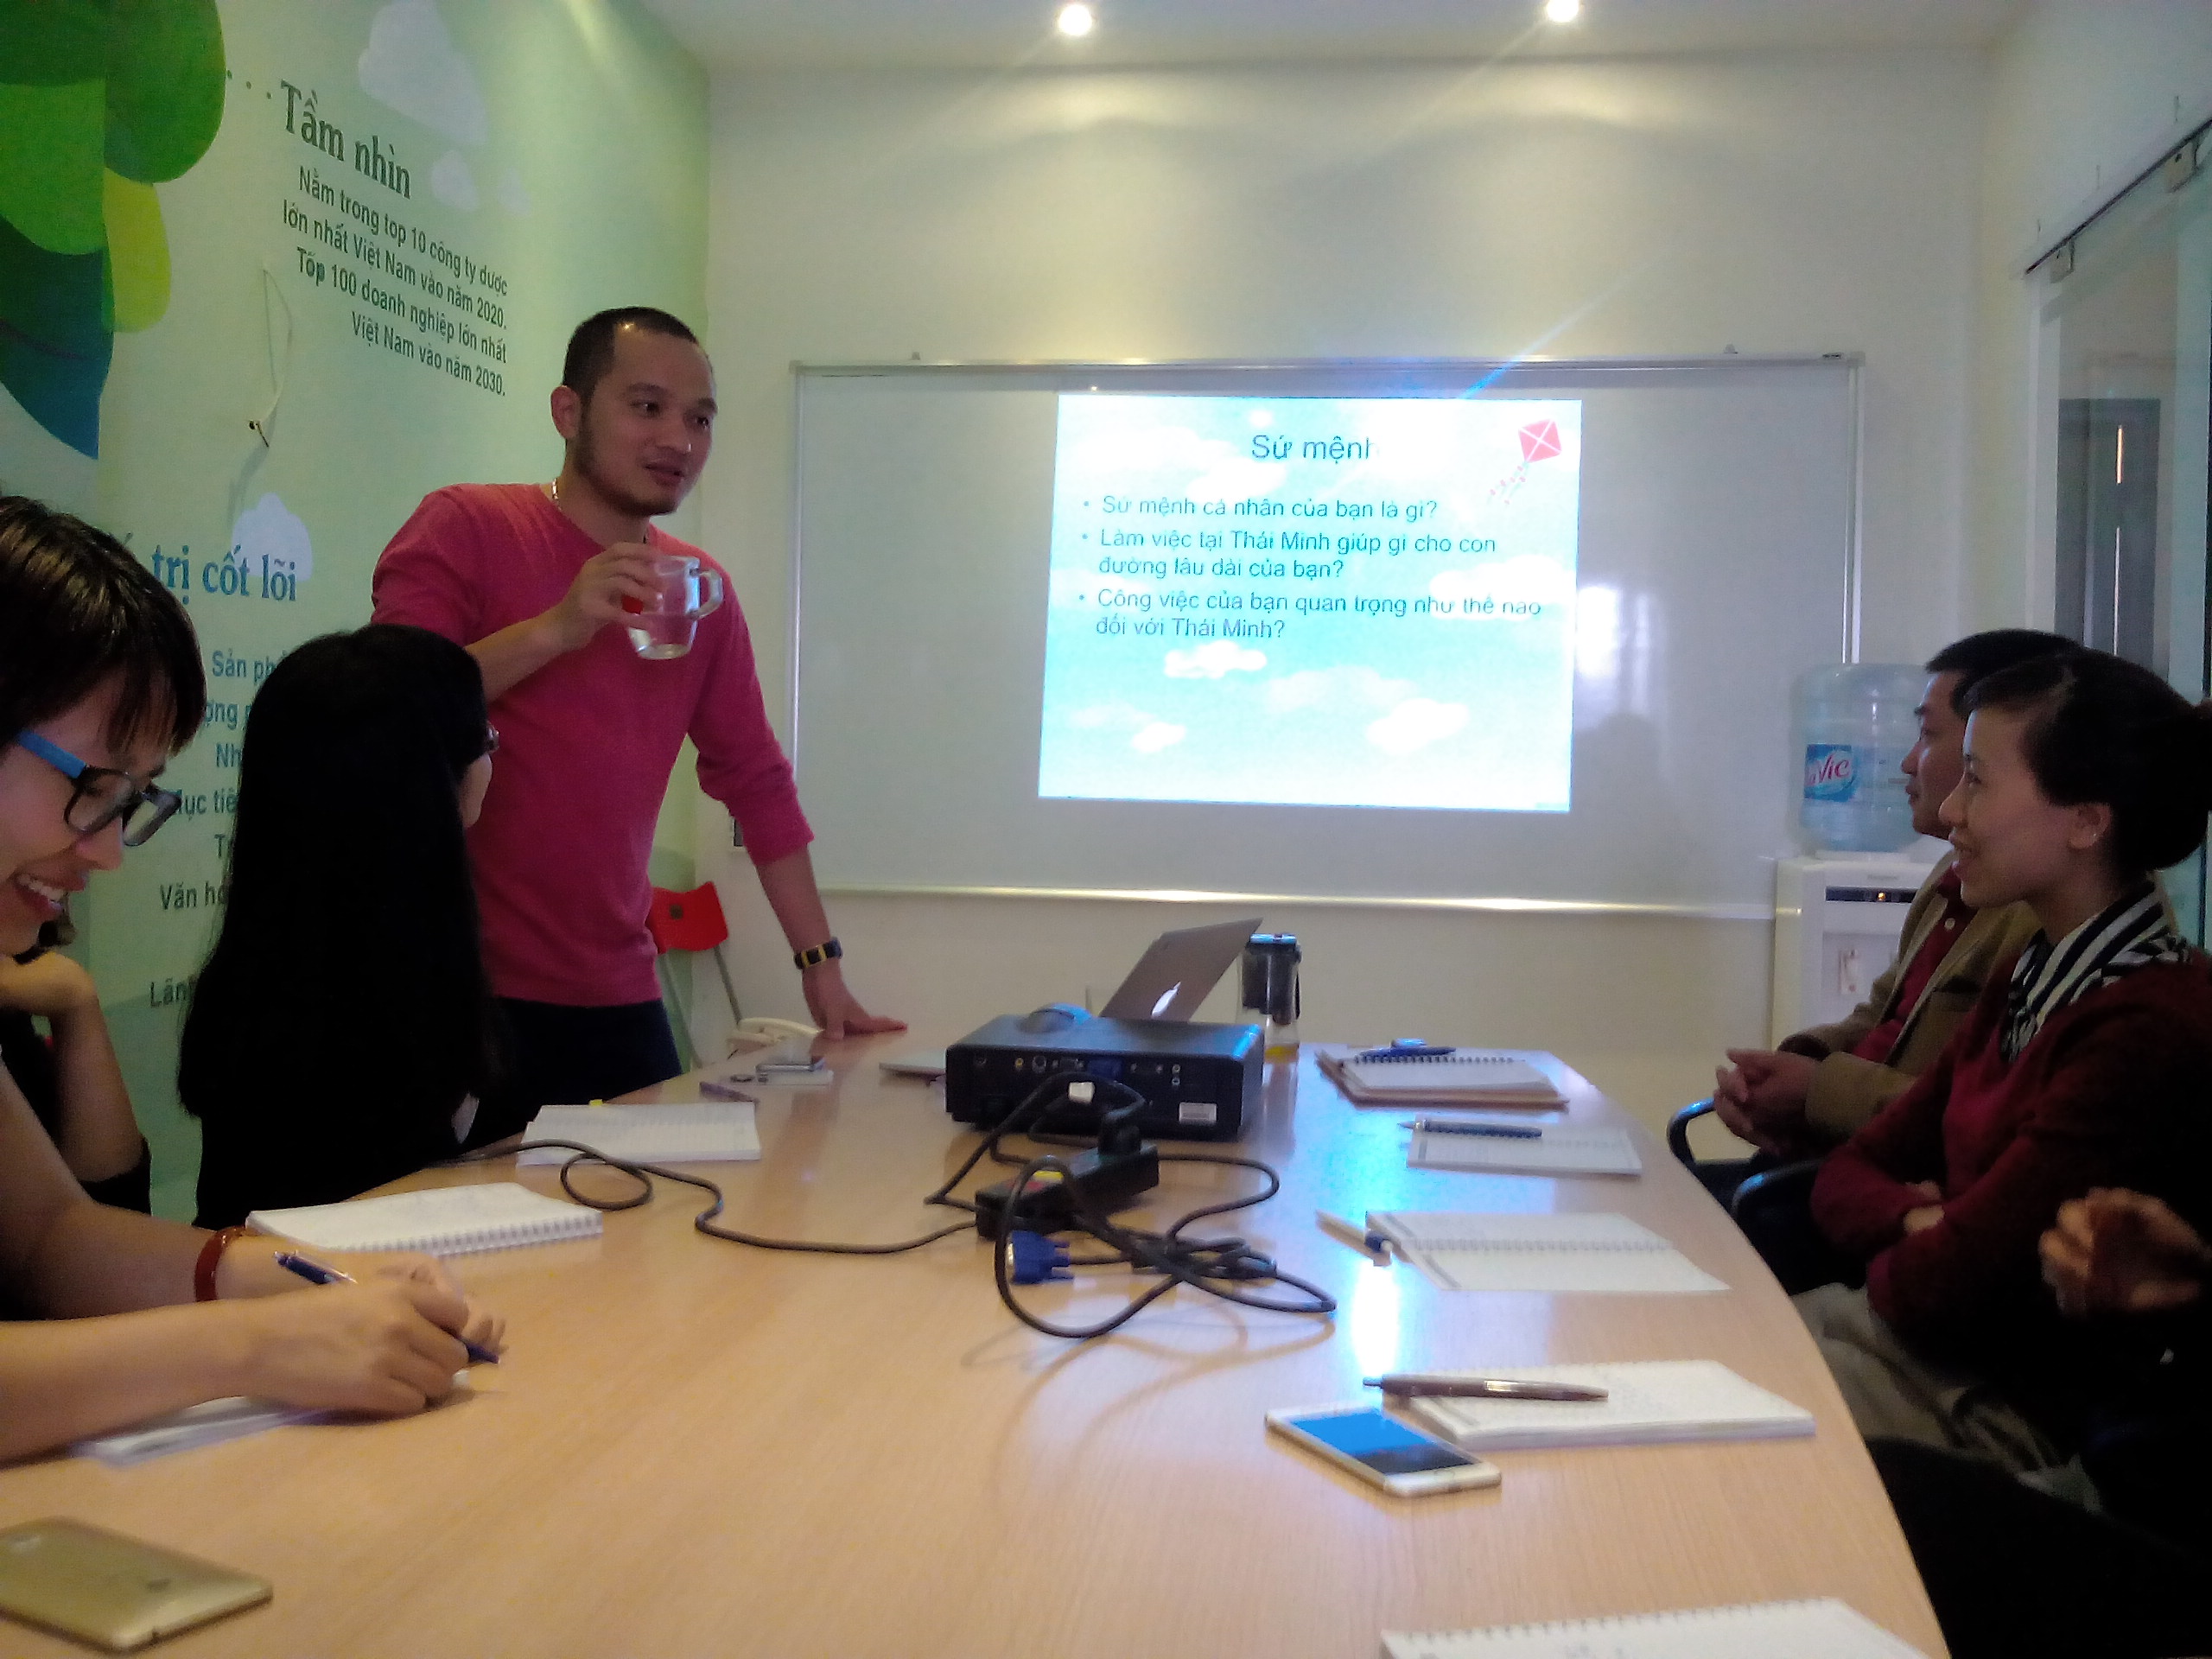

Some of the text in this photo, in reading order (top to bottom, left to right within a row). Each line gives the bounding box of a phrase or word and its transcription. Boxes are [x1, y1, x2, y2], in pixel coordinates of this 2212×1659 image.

[280, 79, 410, 200] Tầm nhìn
[299, 165, 507, 296] Nằm trong top 10 công ty dược
[283, 200, 506, 330] lớn nhất Việt Nam vào năm 2020.
[332, 264, 357, 296] 100
[361, 279, 405, 317] doanh
[410, 307, 454, 343] nghiệp
[459, 322, 477, 350] lớn
[481, 336, 507, 363] nhất
[352, 311, 506, 397] Việt Nam vào năm 2030.
[1252, 435, 1293, 459] Sứ
[1140, 497, 1196, 517] mệnh
[1234, 498, 1285, 517] nhân
[1292, 498, 1328, 518] của
[1337, 499, 1373, 520] bạn
[1101, 528, 1145, 546] Làm
[1152, 530, 1192, 550] việc
[1200, 531, 1223, 551] tại
[1230, 530, 1274, 550] Thái
[1281, 531, 1330, 550] Minh
[1338, 532, 1381, 556] giúp
[1414, 534, 1452, 552] cho
[1459, 537, 1496, 553] con
[152, 543, 296, 605] trị cốt lõi
[1099, 556, 1344, 581] đường lâu dài của bạn?
[1098, 588, 1152, 612] Công
[1160, 590, 1200, 612] việc
[1206, 589, 1243, 610] của
[1250, 591, 1288, 613] bạn
[1295, 596, 1346, 615] quan
[1355, 594, 1407, 617] trọng
[1096, 613, 1286, 638] đối với Thái Minh?
[212, 647, 246, 677] Sản
[213, 787, 239, 814] tiê
[160, 881, 197, 910] Văn
